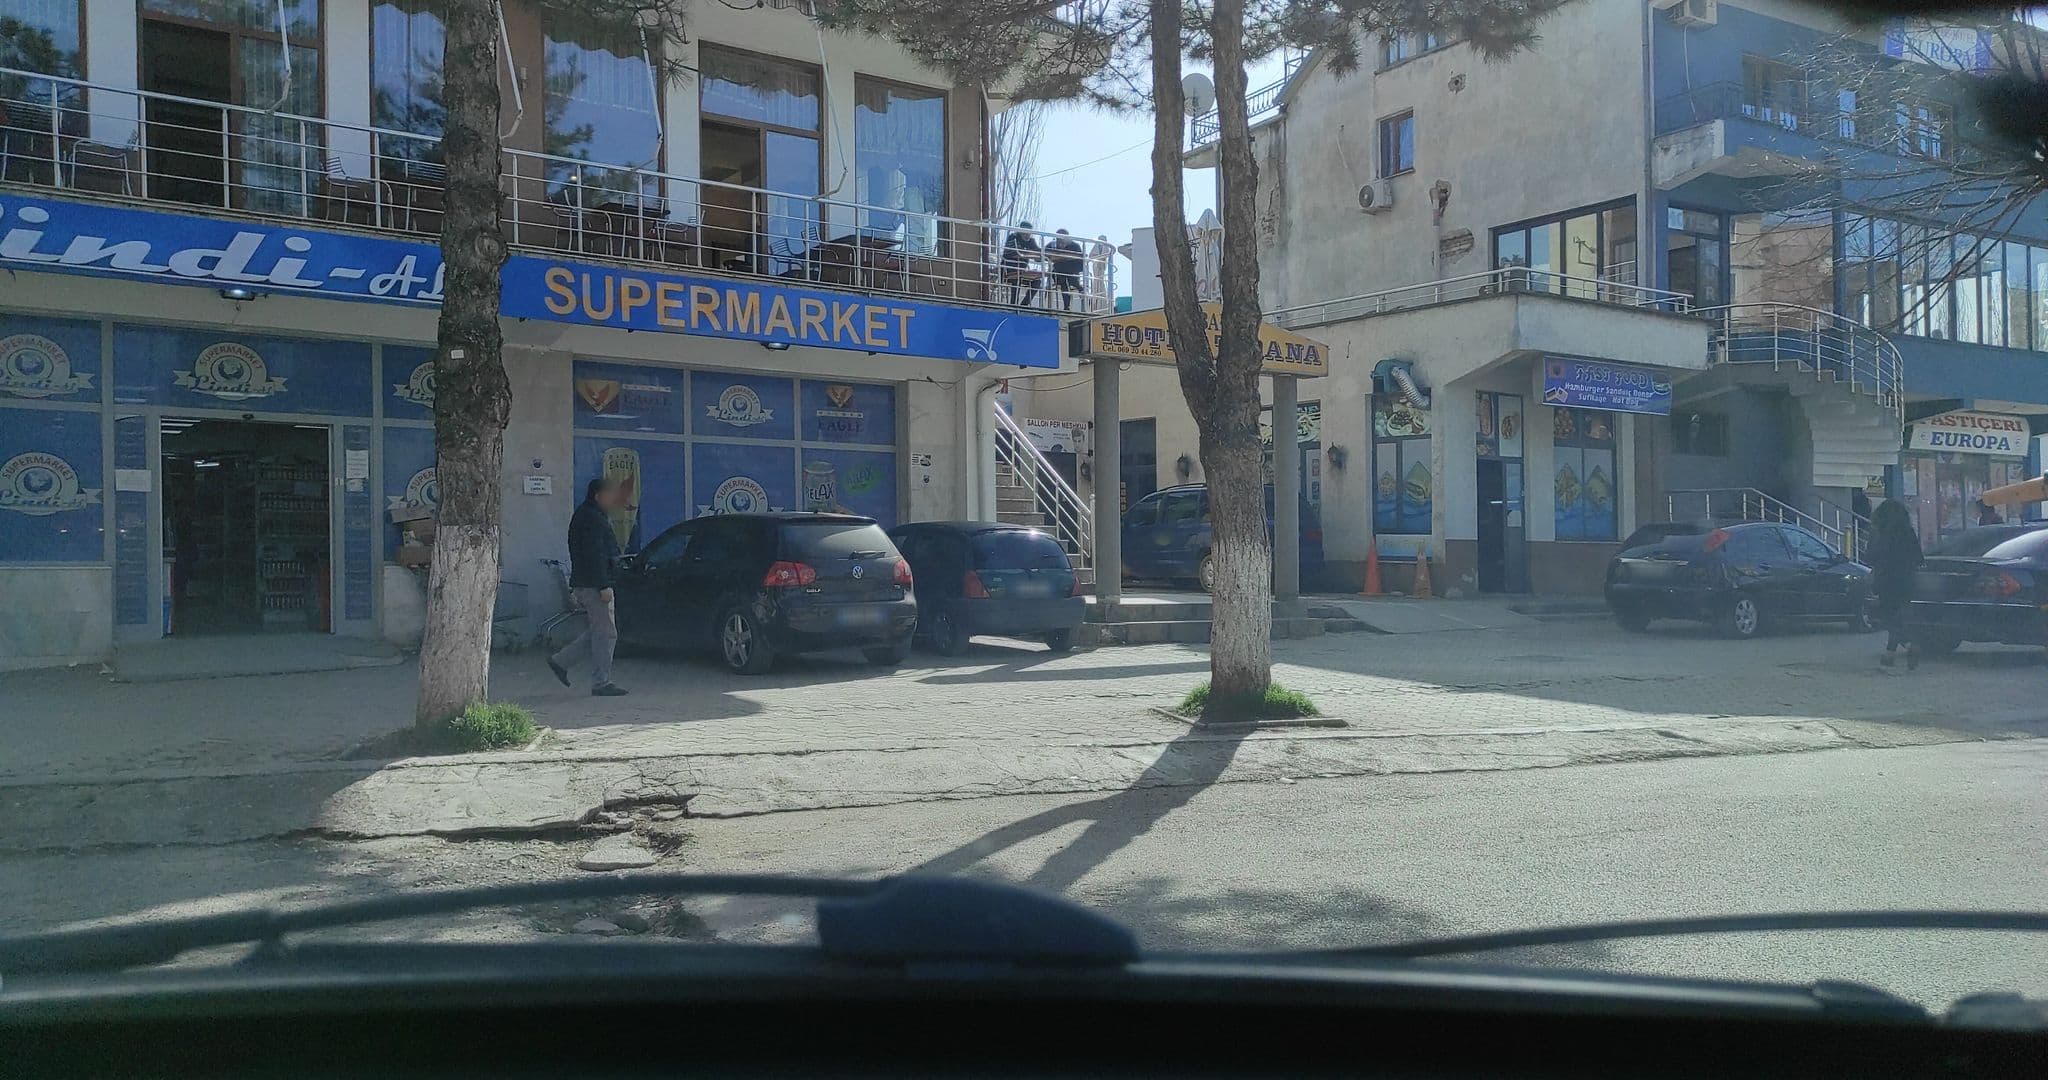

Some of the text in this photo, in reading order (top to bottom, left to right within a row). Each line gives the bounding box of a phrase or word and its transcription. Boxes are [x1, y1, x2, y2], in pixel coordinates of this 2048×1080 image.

[544, 267, 915, 349] SUPERMARKET
[1101, 323, 1175, 350] HOT
[199, 345, 264, 369] SUPERMARKET
[1564, 381, 1605, 394] Hamburger
[1027, 419, 1049, 428] SALLON
[1921, 414, 2023, 432] ASTIÇERI
[1930, 431, 2011, 451] EUROPA
[2, 455, 75, 481] SUPERMARKET
[410, 471, 436, 492] SUPER
[717, 480, 766, 502] SUPERMARKET
